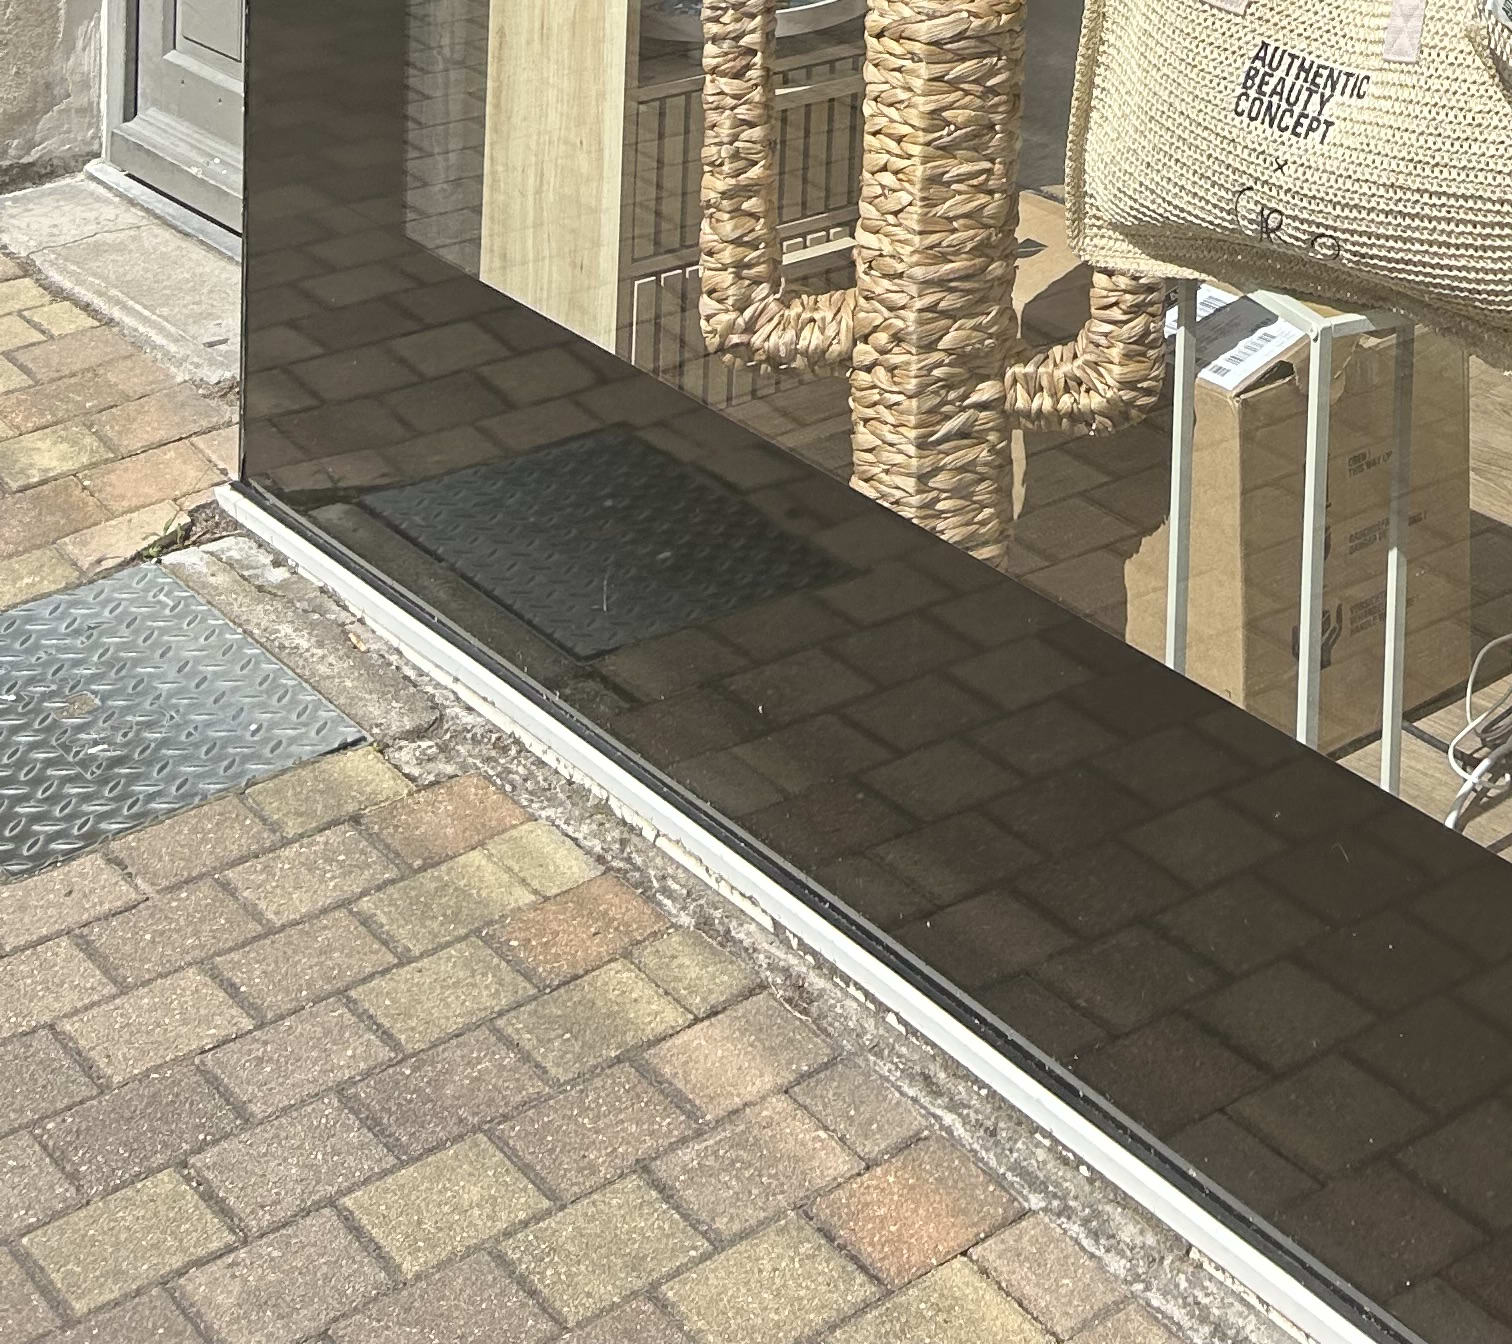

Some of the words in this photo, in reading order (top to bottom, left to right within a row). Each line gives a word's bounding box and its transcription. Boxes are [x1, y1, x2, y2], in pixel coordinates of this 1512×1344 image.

[1241, 65, 1335, 117] BEAUTY
[1250, 40, 1371, 100] AUTHENTIC
[1234, 91, 1336, 146] CONCEPT
